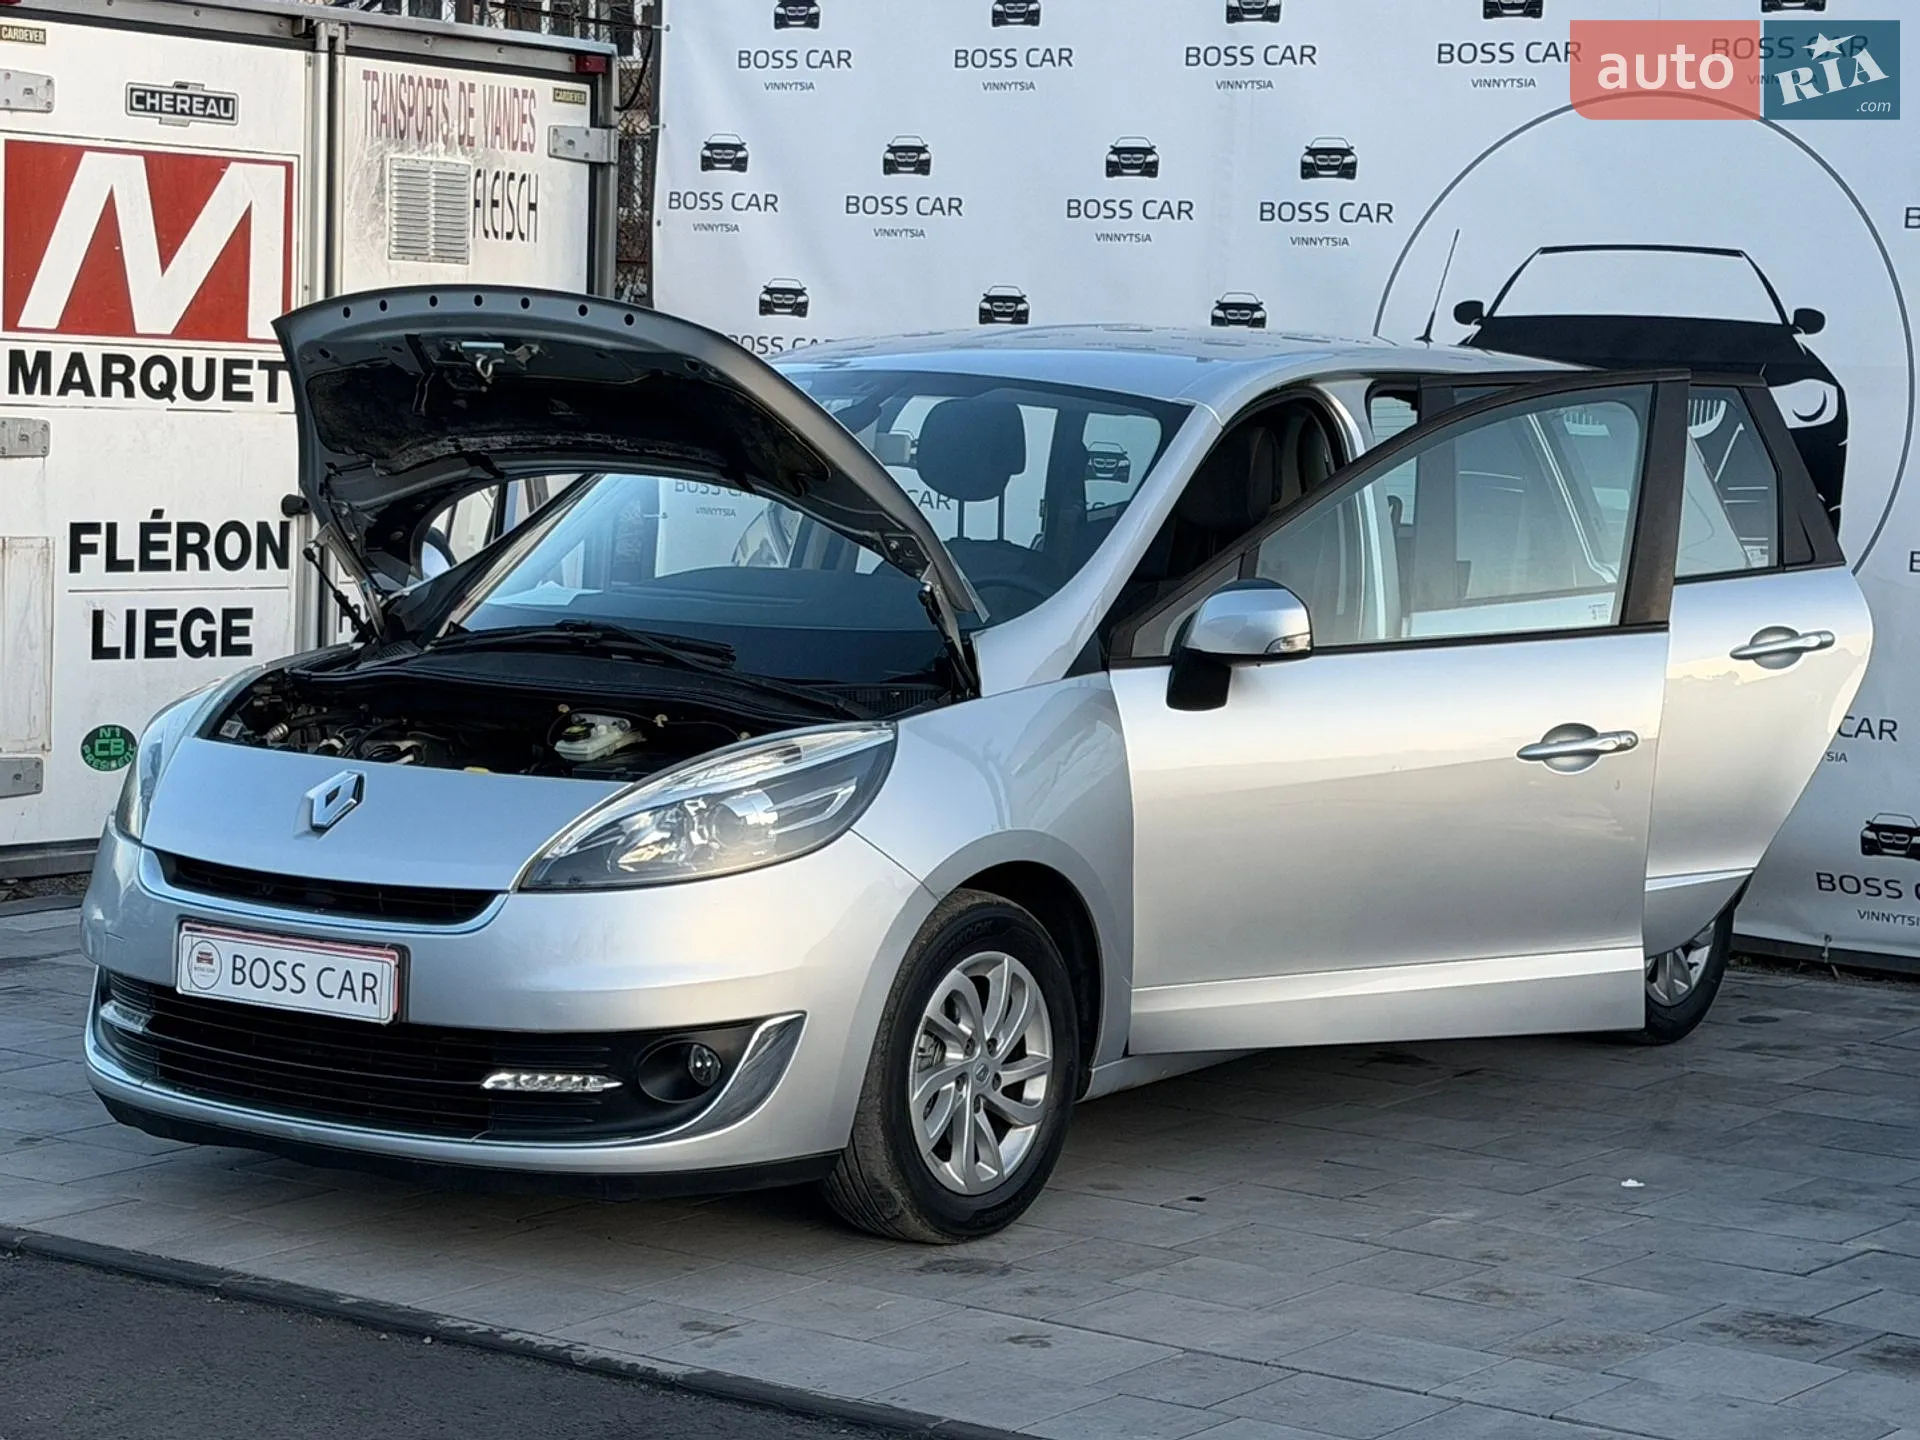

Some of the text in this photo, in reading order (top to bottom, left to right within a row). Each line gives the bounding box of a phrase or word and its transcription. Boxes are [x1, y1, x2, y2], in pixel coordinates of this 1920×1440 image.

[737, 49, 852, 70] BOSS CAR
[954, 47, 1073, 69] BOSS CAR
[1185, 44, 1317, 67] BOSS CAR
[1437, 41, 1583, 65] BOSS CAR
[763, 81, 816, 92] VINNYTSIA
[982, 80, 1036, 92] VINNYTSIA
[1215, 79, 1274, 90] VINNYTSIA
[1470, 77, 1537, 89] VINNYTSIA
[131, 91, 234, 118] CHEREAU
[363, 70, 537, 153] TRANSPORTS DE VIANDES
[473, 168, 540, 243] FLEISCH
[668, 190, 779, 213] BOSS CAR
[845, 195, 963, 217] BOSS CAR
[1066, 198, 1194, 221] BOSS CAR
[1259, 201, 1394, 224] BOSS CAR
[692, 222, 740, 233] VINNYTSIA
[873, 228, 926, 239] VINNYTSIA
[1094, 232, 1152, 243] VINNYTSIA
[16, 150, 287, 340] M
[1289, 236, 1350, 247] VINNYTSIA
[7, 349, 290, 404] MARQUET
[68, 508, 291, 574] FLÉRON
[91, 606, 254, 661] LIEGE
[1837, 715, 1899, 742] CAR
[95, 738, 125, 757] CB
[1815, 871, 1903, 900] BOSS
[1857, 909, 1920, 927] VINNYTSI
[231, 954, 379, 1005] BOSS CAR
